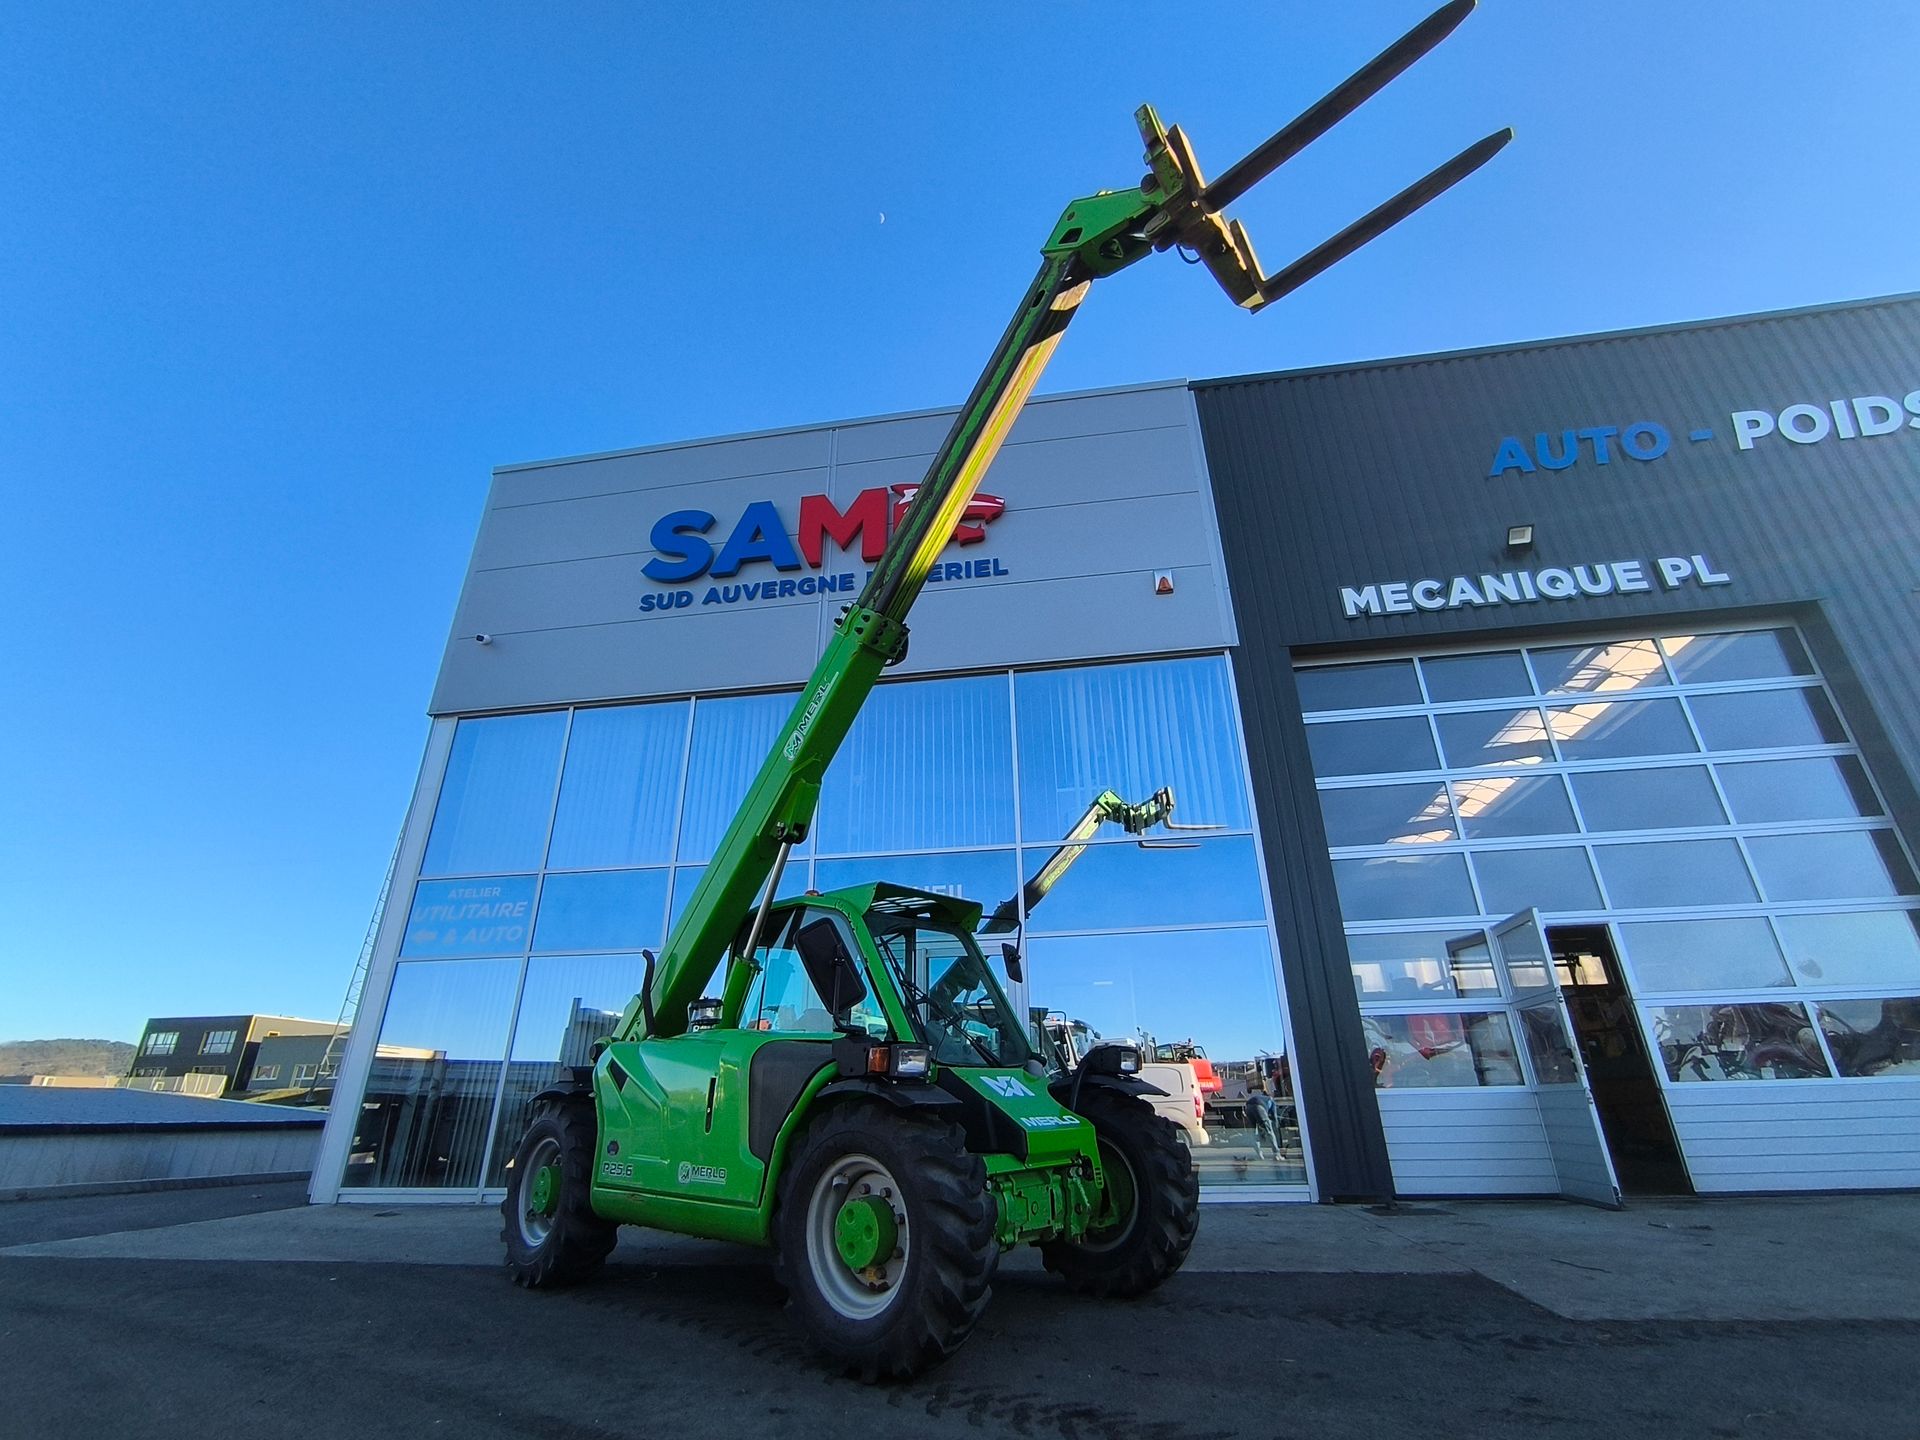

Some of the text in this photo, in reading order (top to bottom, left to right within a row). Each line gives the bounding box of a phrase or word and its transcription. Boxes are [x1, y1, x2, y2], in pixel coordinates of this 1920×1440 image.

[1489, 421, 1671, 478] AUTO
[639, 589, 694, 612] SUD
[702, 571, 856, 606] AUVERGNE
[1340, 555, 1731, 618] MECANIQUE PL
[798, 676, 829, 732] MERL
[448, 887, 501, 899] ATELIER
[413, 901, 528, 923] UTILITAIRE
[461, 925, 524, 945] AUTO
[1020, 1115, 1080, 1127] MERLO
[692, 1166, 727, 1180] MERLO
